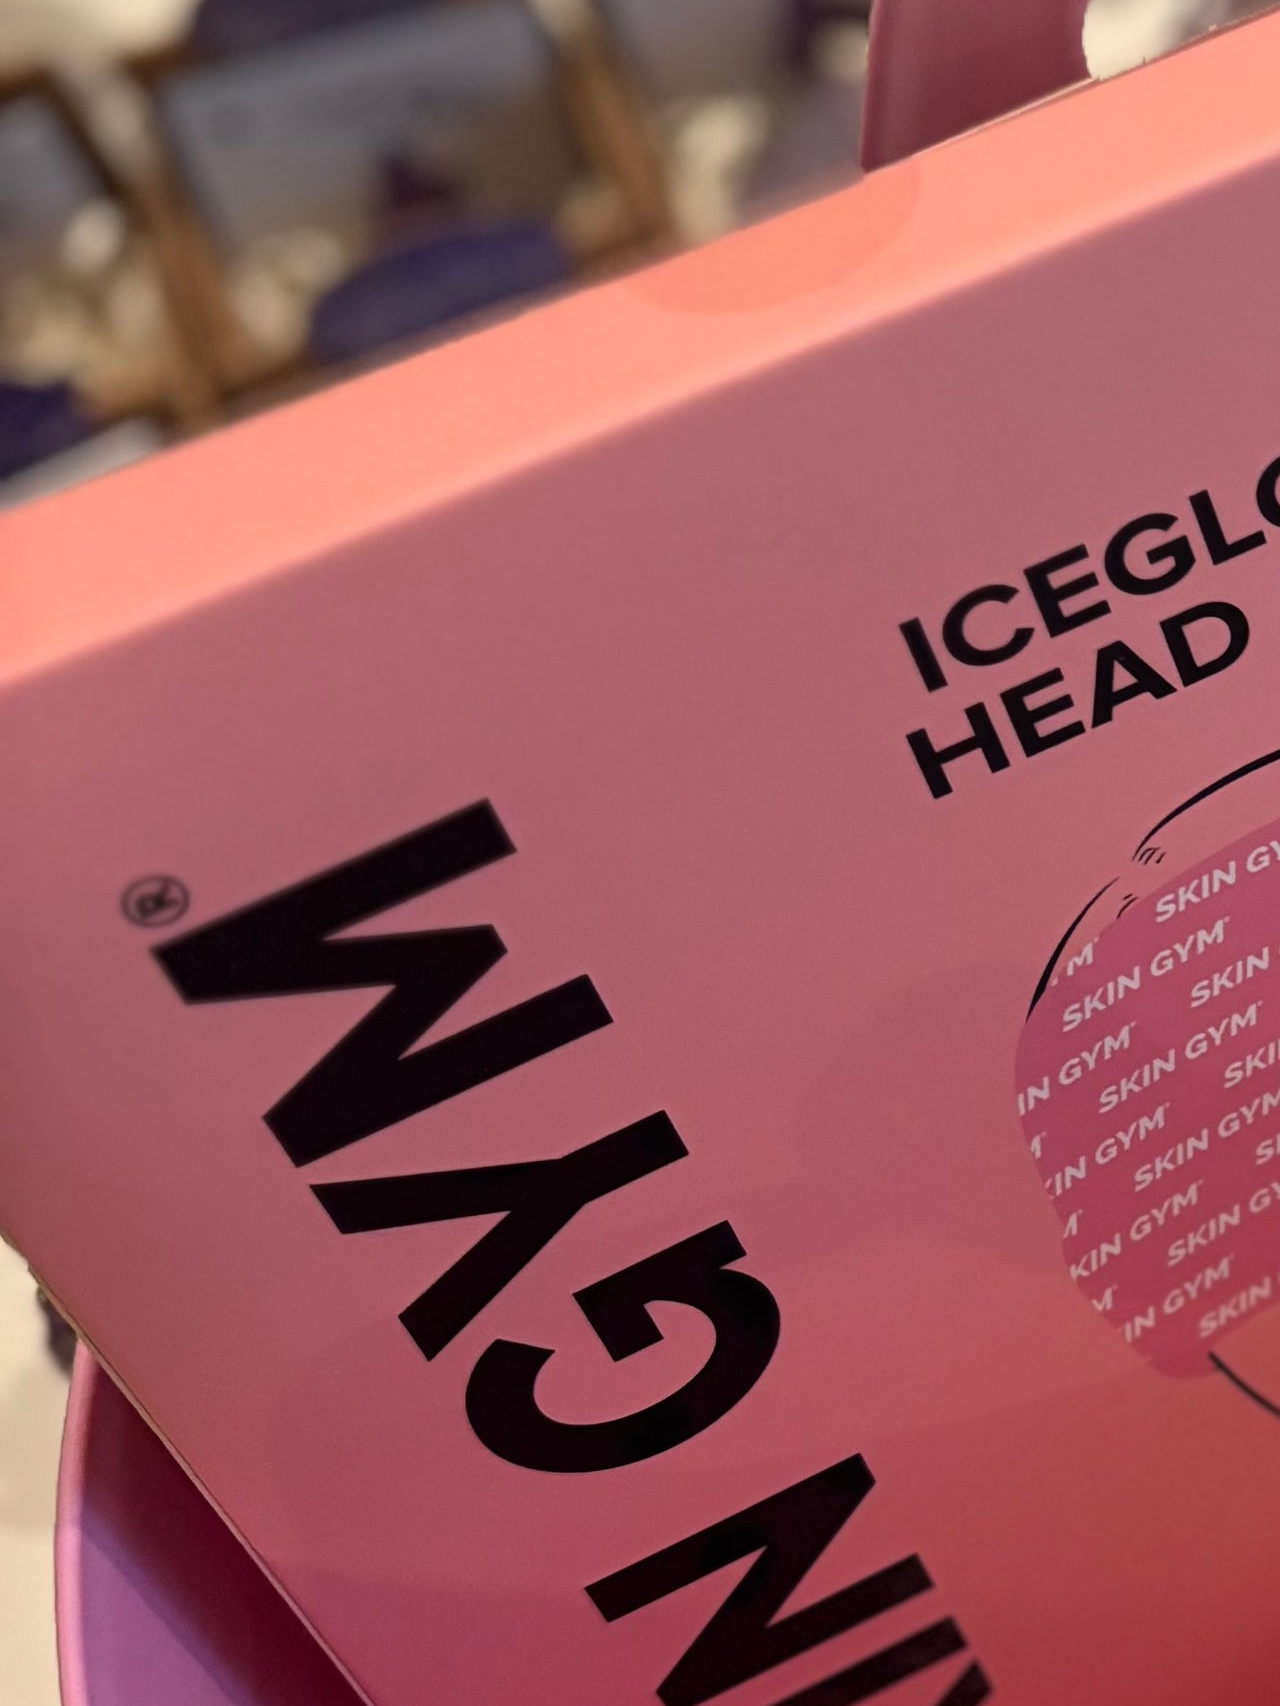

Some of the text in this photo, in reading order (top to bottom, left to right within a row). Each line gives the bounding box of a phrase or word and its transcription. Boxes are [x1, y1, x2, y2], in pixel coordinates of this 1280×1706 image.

[905, 600, 1251, 800] HEAD
[1154, 860, 1237, 924] SKIN
[1062, 965, 1141, 1033] SKIN
[1150, 919, 1225, 977] GYM
[1190, 946, 1270, 1009] SKIN
[1058, 1024, 1131, 1086] GYM
[1098, 1004, 1258, 1114] SKIN GYM
[1094, 1106, 1168, 1165] GYM
[1133, 1129, 1210, 1192] SKIN
[1129, 1182, 1201, 1242] GYM
[1167, 1204, 1241, 1267] SKIN
[1162, 1257, 1232, 1315] GYM
[1198, 1278, 1272, 1339] SKIN
